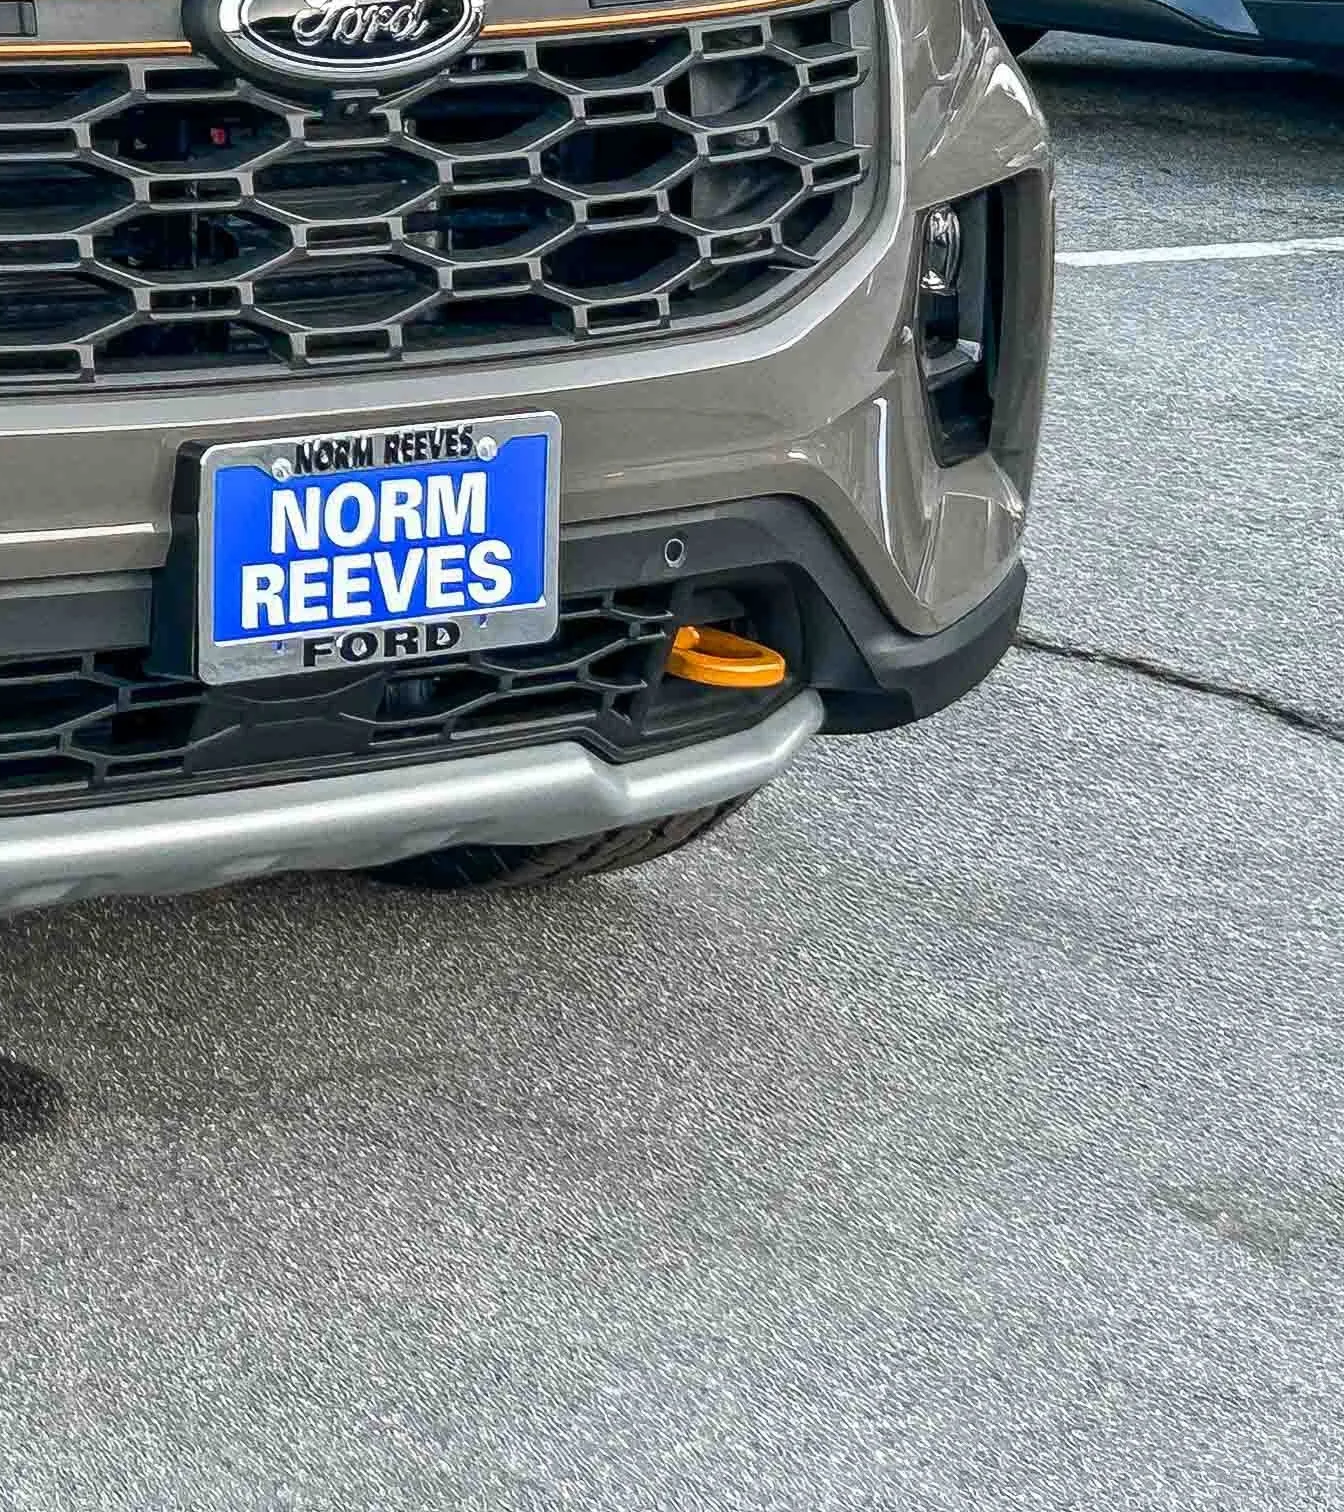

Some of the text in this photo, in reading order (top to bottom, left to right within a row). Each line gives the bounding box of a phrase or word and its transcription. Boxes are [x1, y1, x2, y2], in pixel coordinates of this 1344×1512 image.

[295, 425, 473, 475] NORM REEVES
[271, 472, 488, 554] NORM
[241, 539, 513, 630] REEVES
[303, 621, 462, 667] FORD
